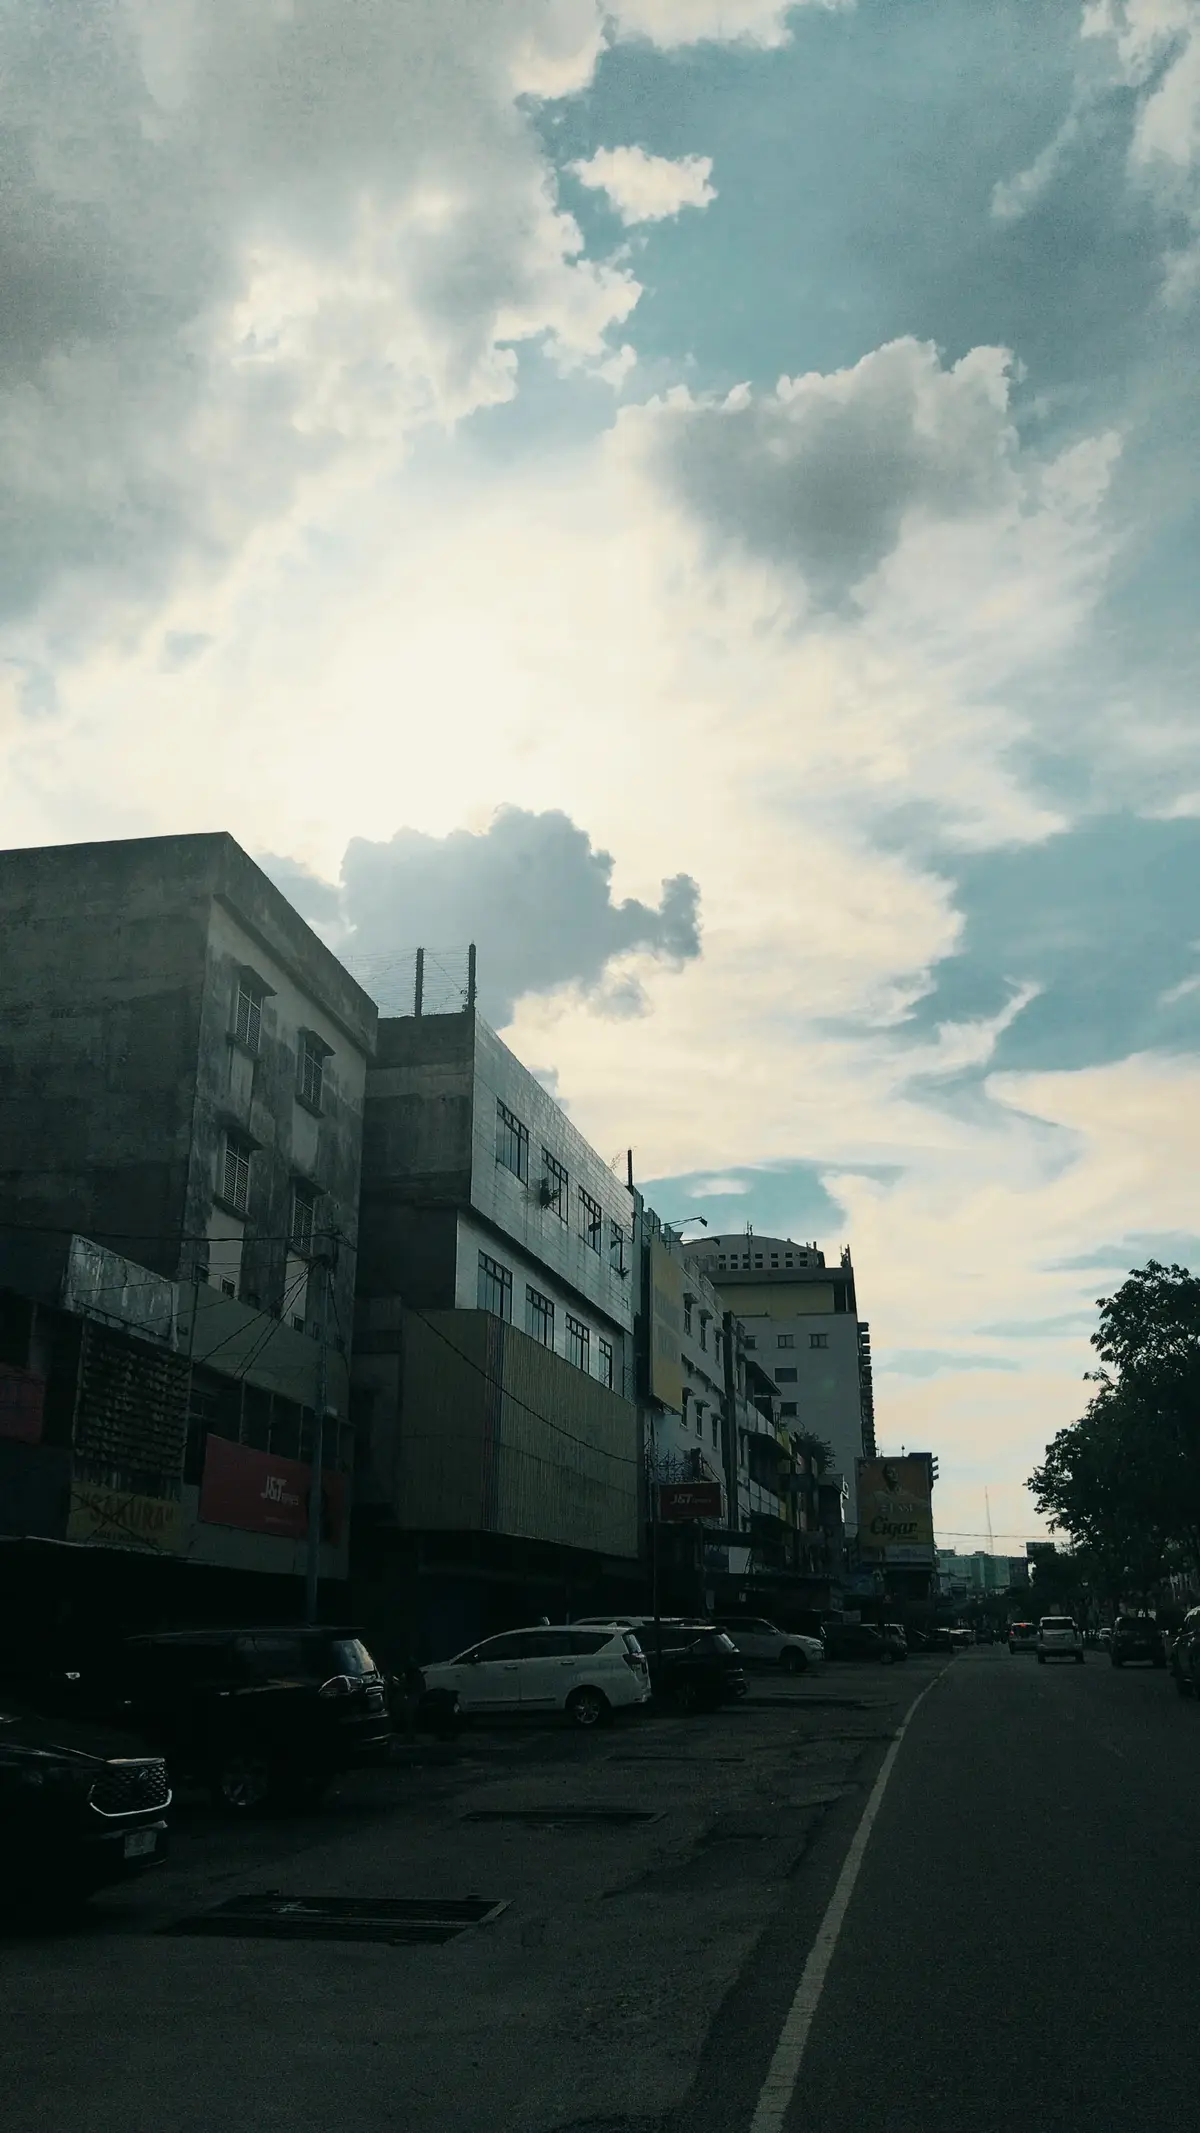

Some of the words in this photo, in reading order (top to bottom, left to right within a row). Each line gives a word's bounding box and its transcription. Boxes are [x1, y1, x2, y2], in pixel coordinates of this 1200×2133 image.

[260, 1474, 288, 1502] J&T
[669, 1493, 694, 1505] J&T
[870, 1515, 918, 1540] Cigar
